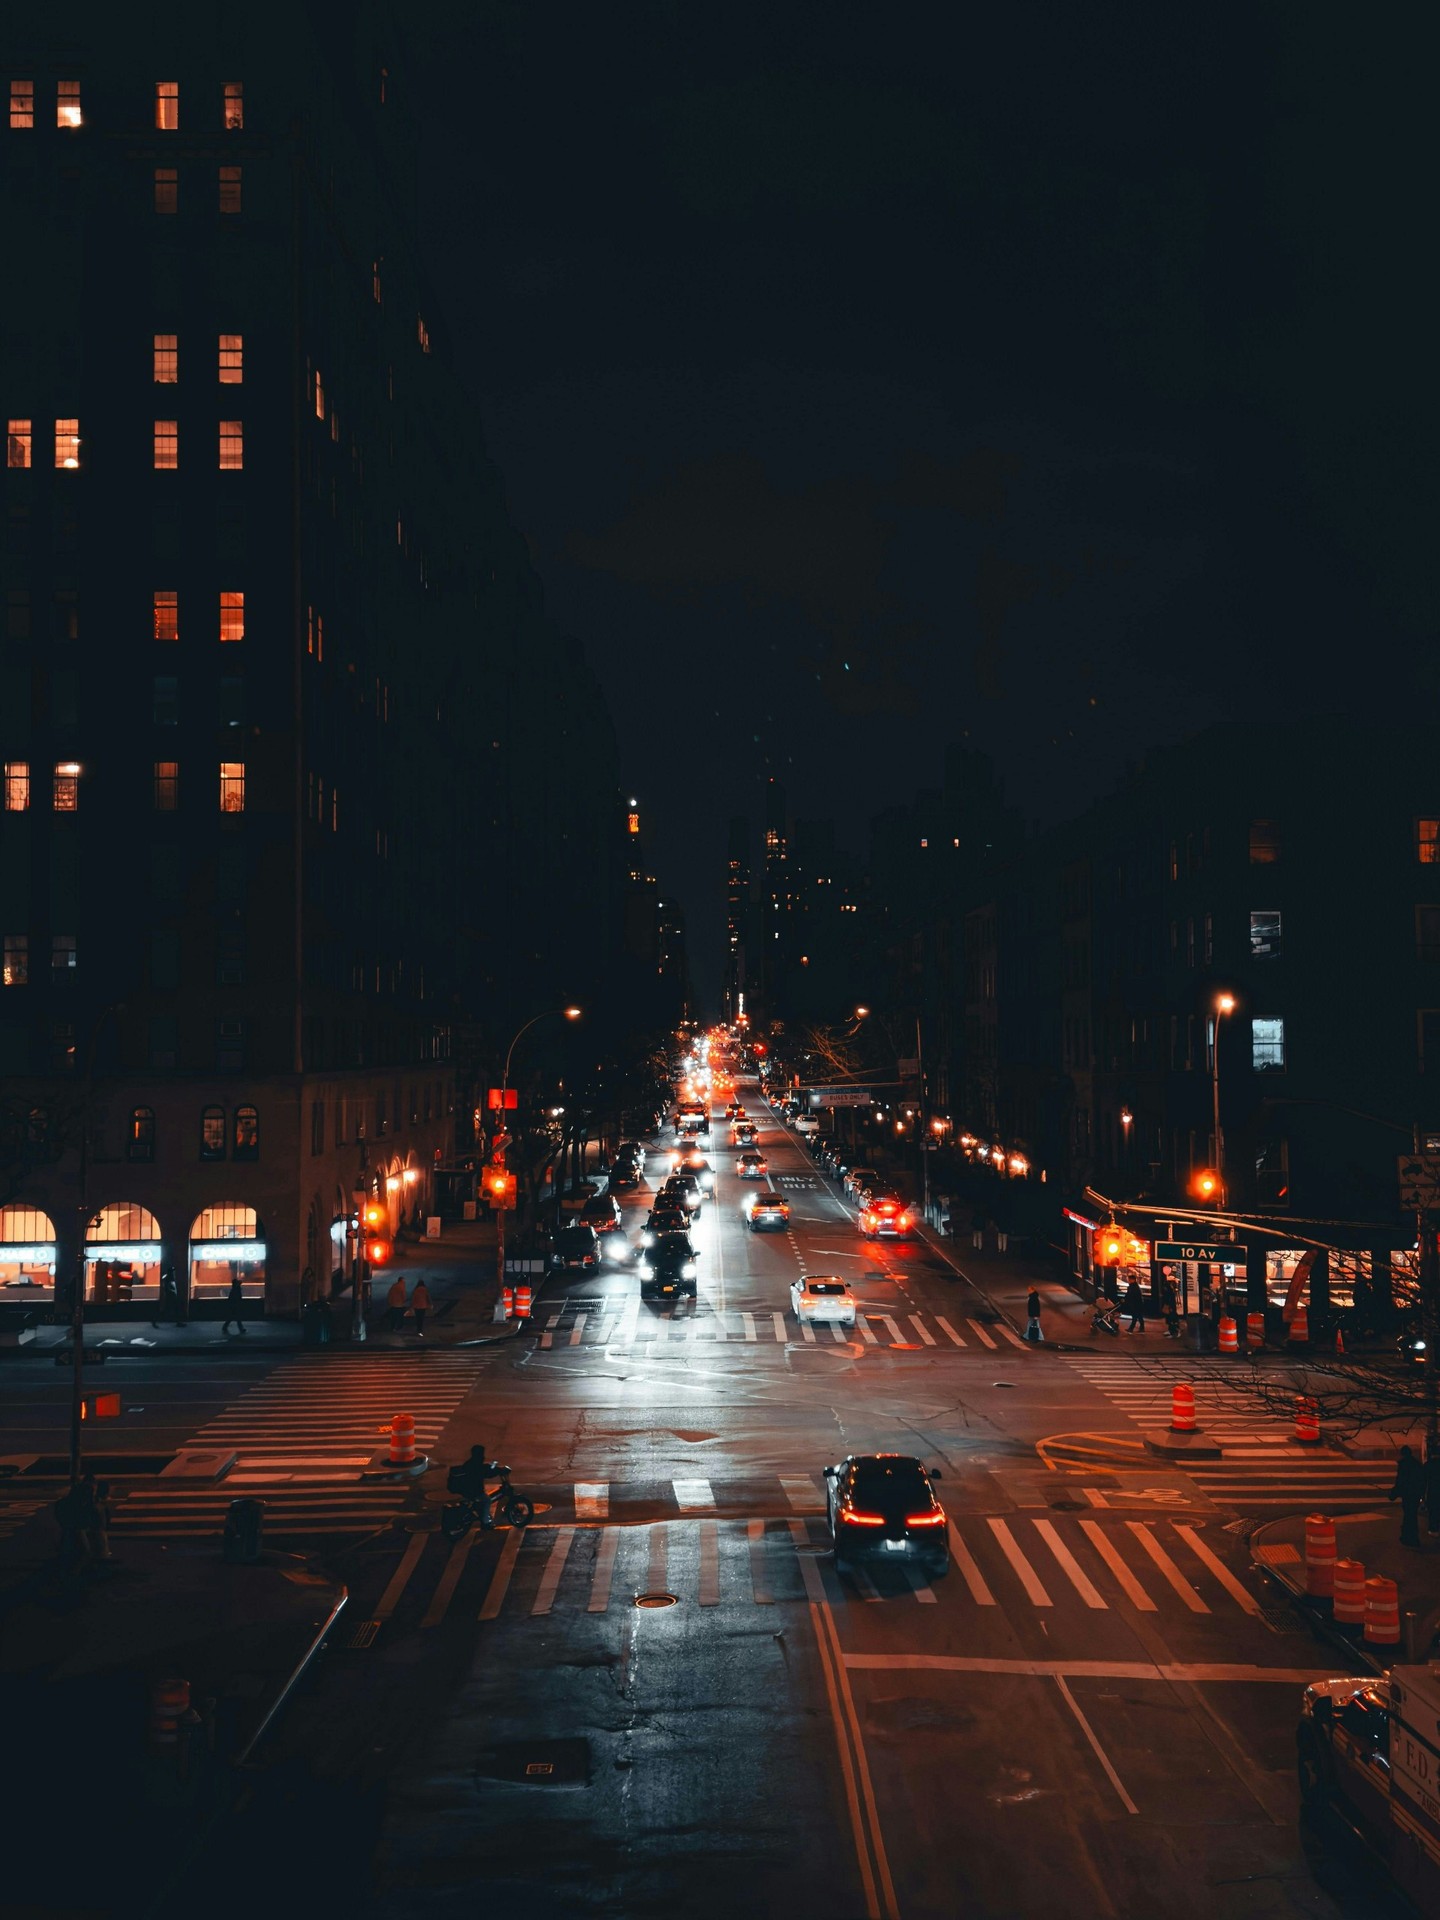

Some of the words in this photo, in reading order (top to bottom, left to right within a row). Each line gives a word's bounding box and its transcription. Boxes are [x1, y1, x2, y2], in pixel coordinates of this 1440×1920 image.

[0, 1249, 35, 1260] HASE
[201, 1246, 245, 1259] CHASE
[1181, 1247, 1195, 1258] 10
[1198, 1248, 1216, 1260] Av
